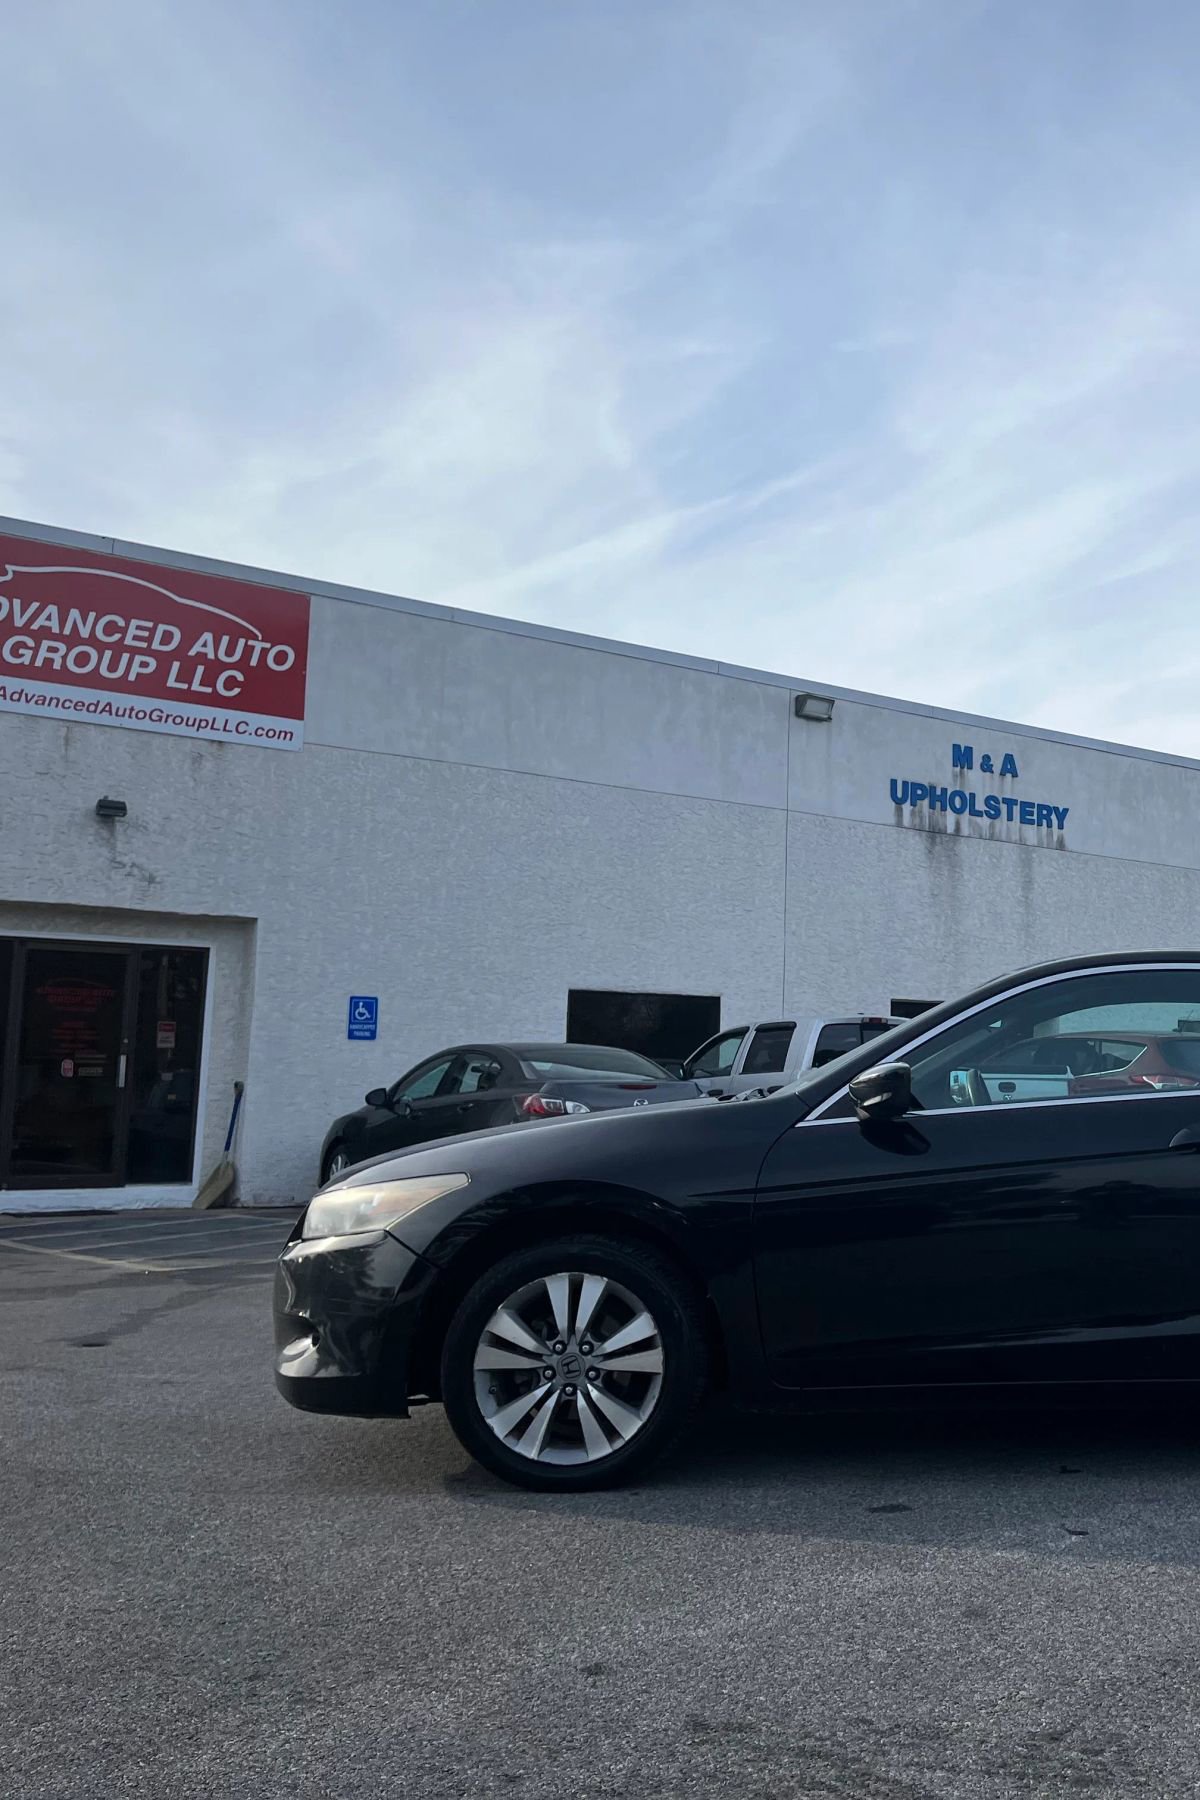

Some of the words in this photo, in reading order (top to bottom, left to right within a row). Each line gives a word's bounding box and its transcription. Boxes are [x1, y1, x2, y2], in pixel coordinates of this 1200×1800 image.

[2, 635, 157, 682] GROUP
[166, 661, 245, 697] LLC
[188, 631, 296, 672] AUTO
[952, 743, 974, 770] M
[980, 754, 994, 774] &
[1000, 753, 1019, 778] A
[890, 778, 1070, 830] UPHOLSTERY
